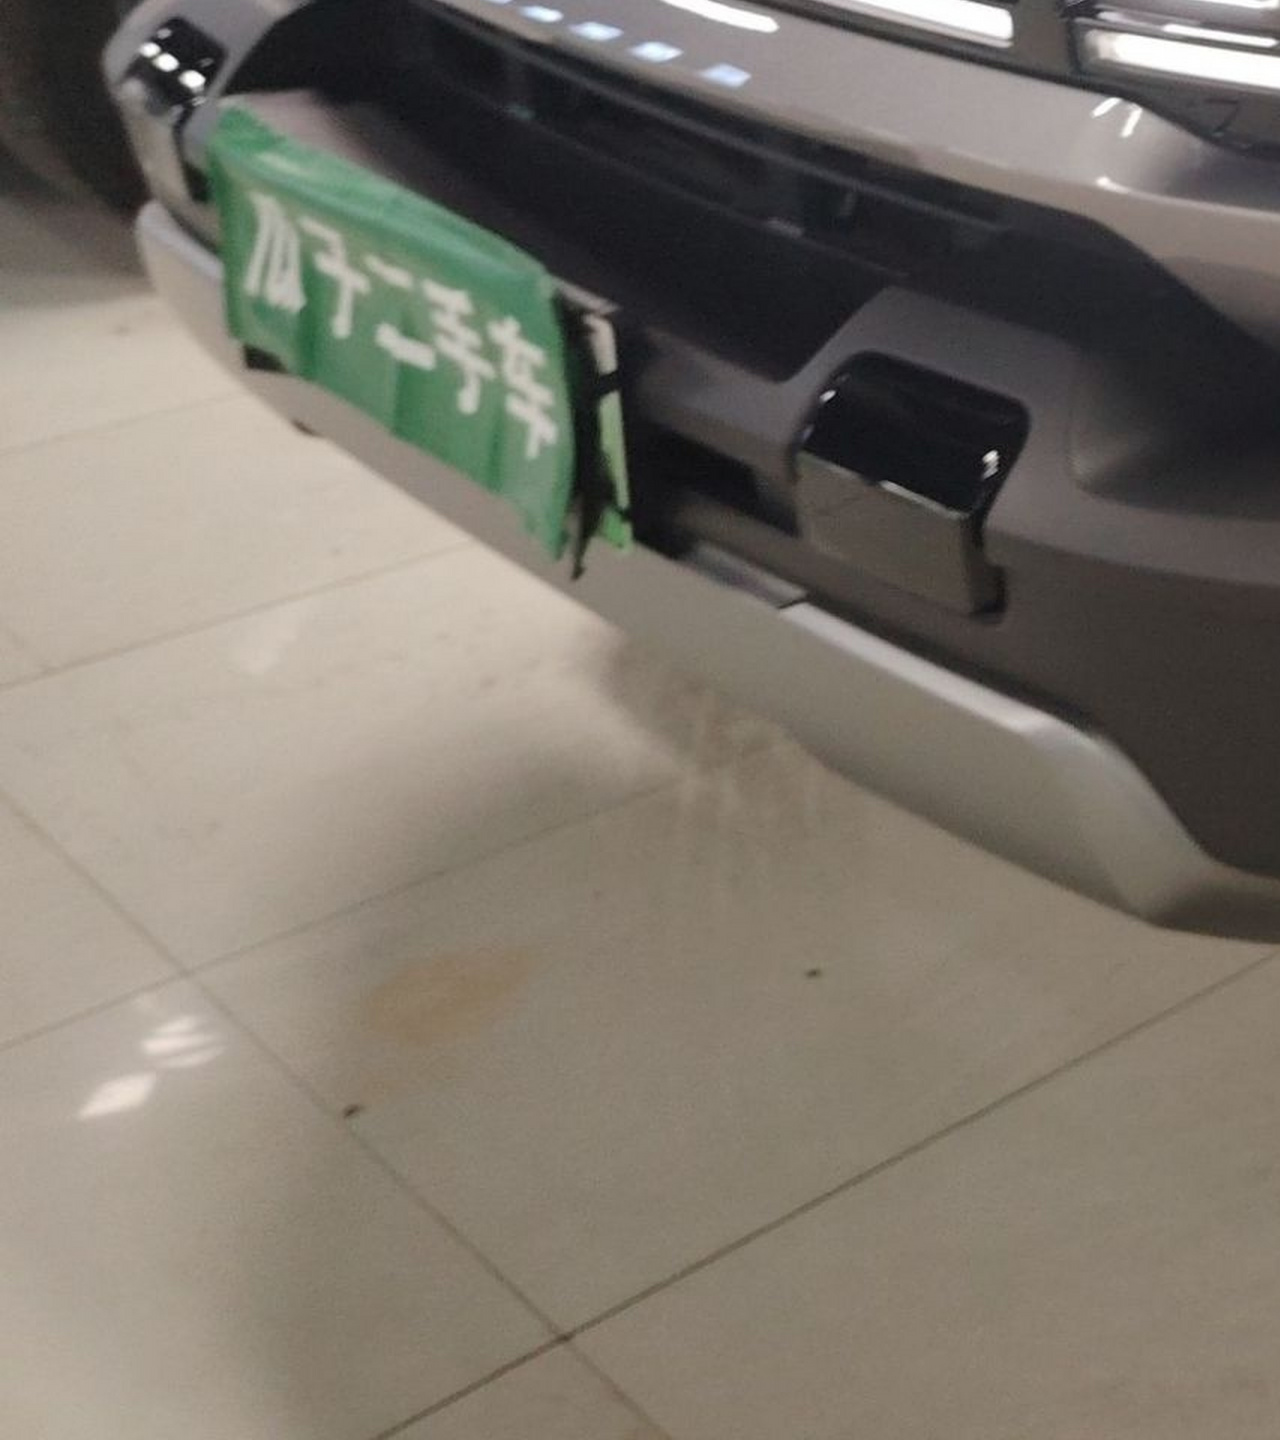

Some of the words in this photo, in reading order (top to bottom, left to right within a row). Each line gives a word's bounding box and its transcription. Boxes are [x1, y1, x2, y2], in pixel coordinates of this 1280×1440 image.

[244, 192, 557, 460] 瓜子二手车
